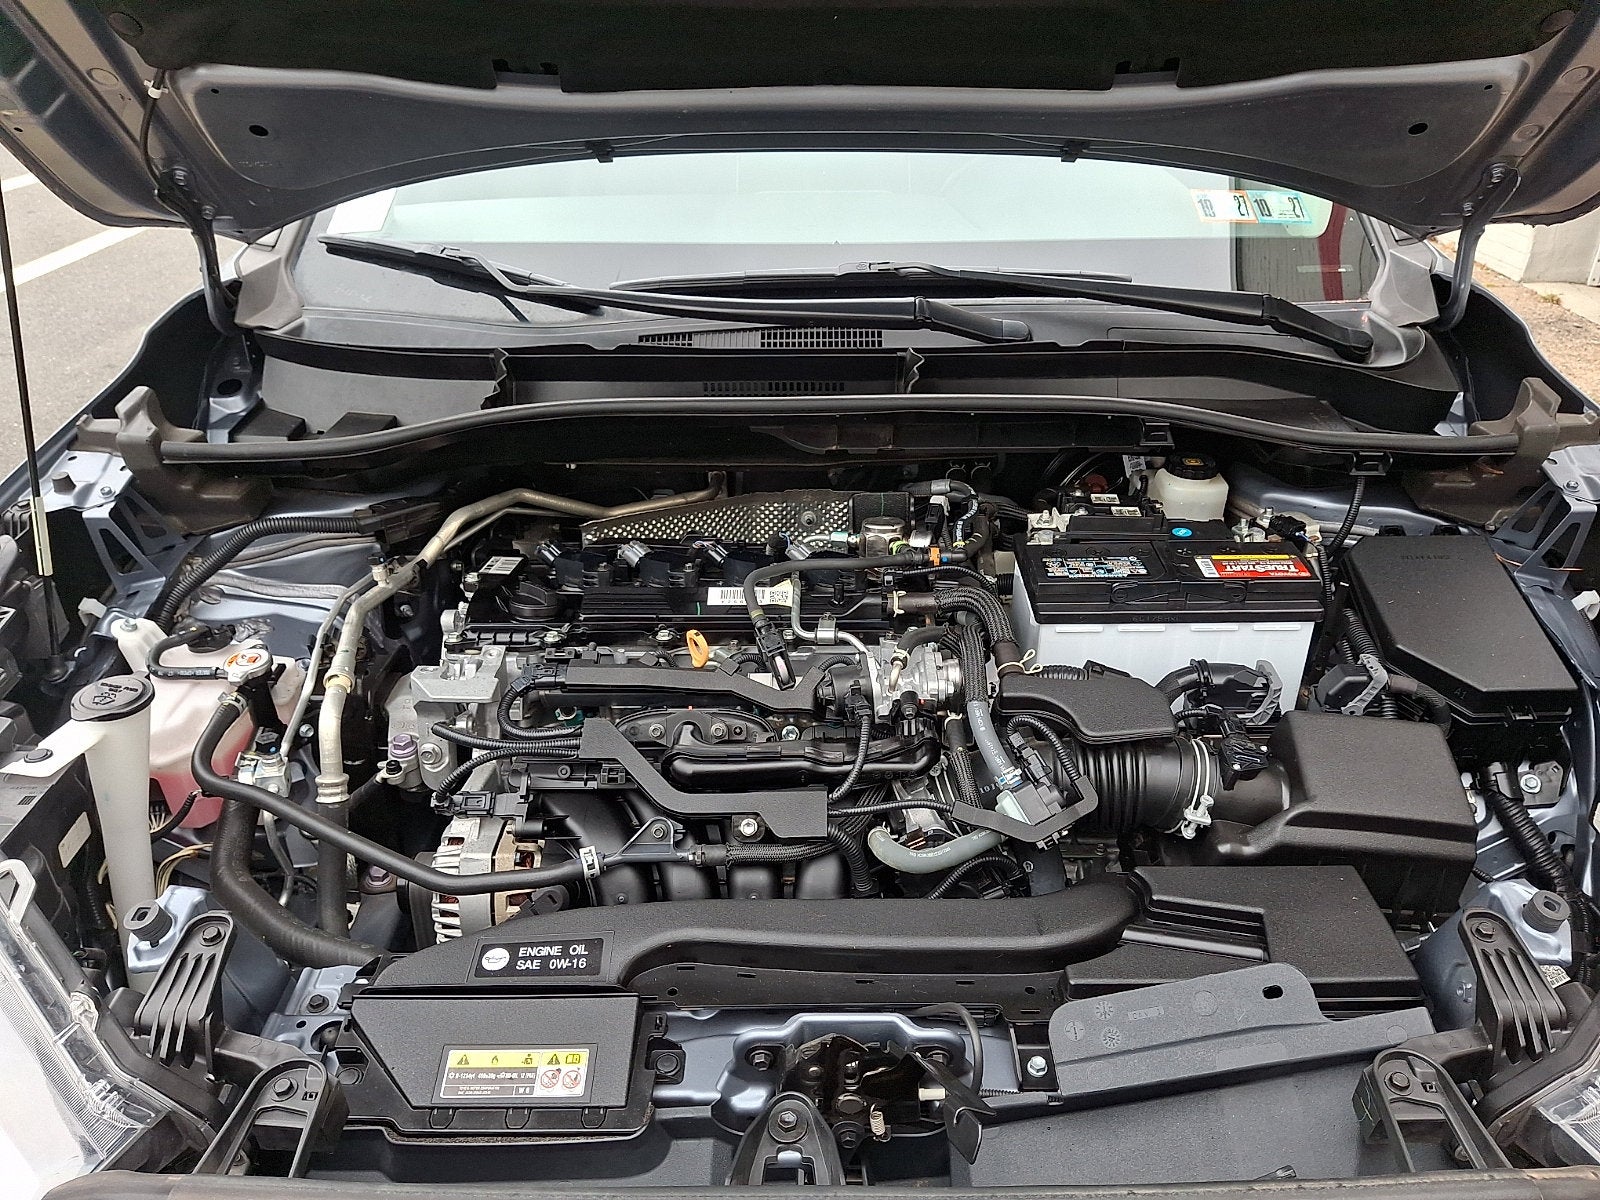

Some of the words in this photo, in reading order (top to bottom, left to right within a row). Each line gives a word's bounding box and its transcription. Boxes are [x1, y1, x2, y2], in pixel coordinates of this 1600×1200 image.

[1233, 195, 1250, 217] 27
[1253, 198, 1273, 217] 10
[1287, 196, 1305, 218] 27
[518, 945, 562, 957] ENGINE
[569, 944, 588, 955] OIL
[516, 959, 541, 970] SAE
[549, 958, 587, 969] 0W-16
